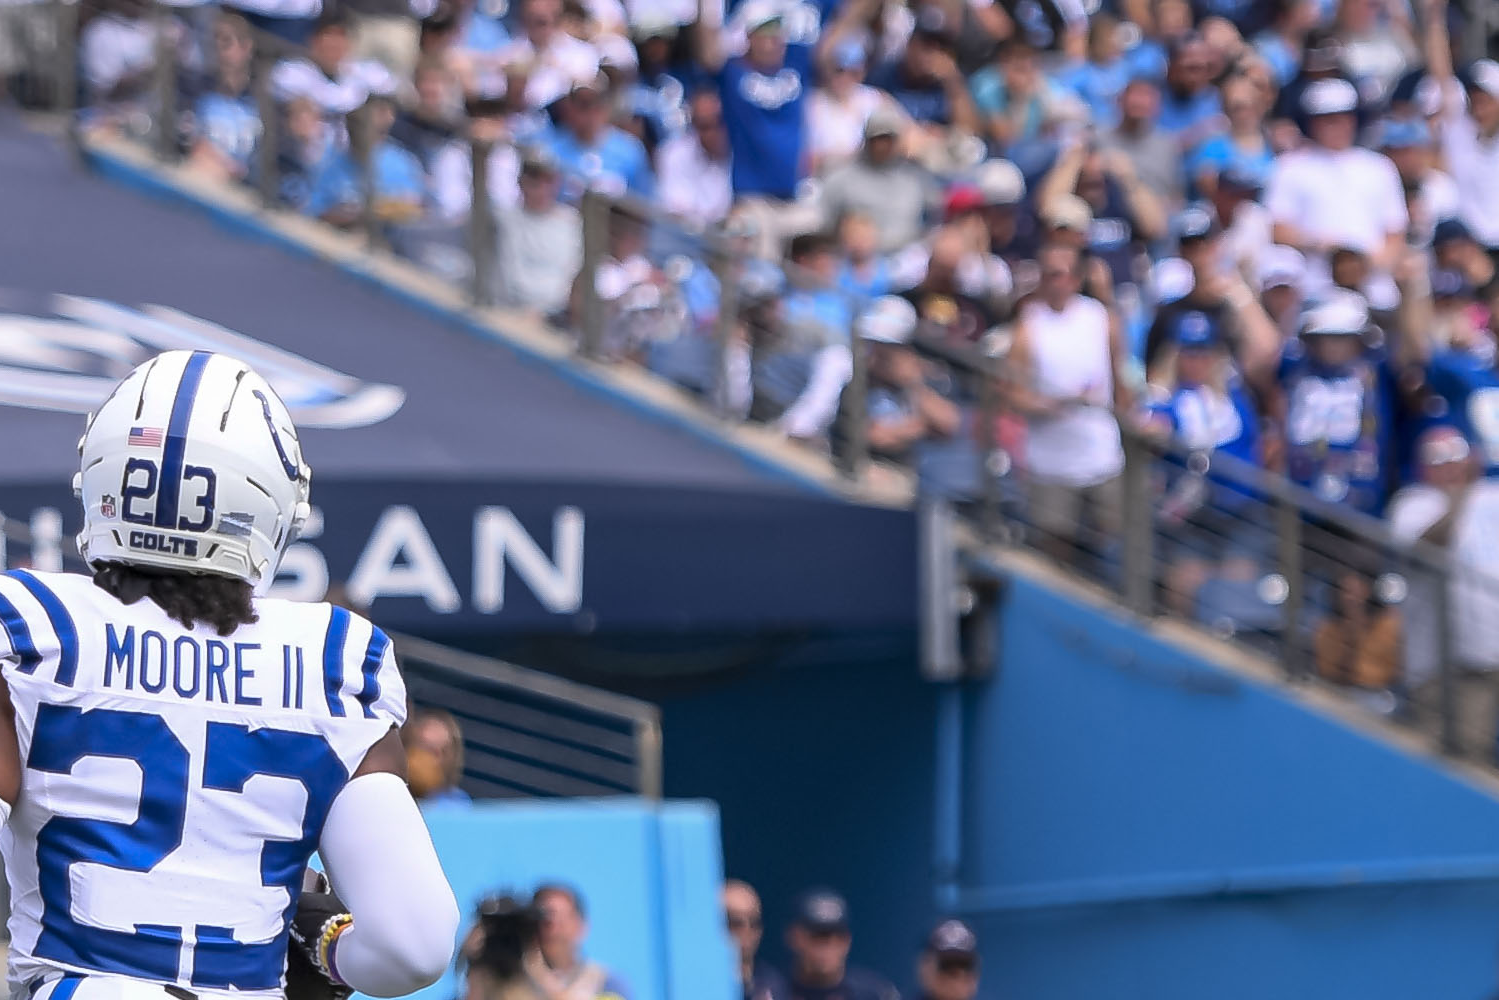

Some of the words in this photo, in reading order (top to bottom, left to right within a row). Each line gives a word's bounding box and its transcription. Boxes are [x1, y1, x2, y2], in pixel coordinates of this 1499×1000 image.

[121, 457, 217, 533] 23
[129, 530, 199, 557] COLTS
[103, 623, 263, 706] MOORE
[282, 644, 304, 709] II
[26, 701, 350, 991] 23
